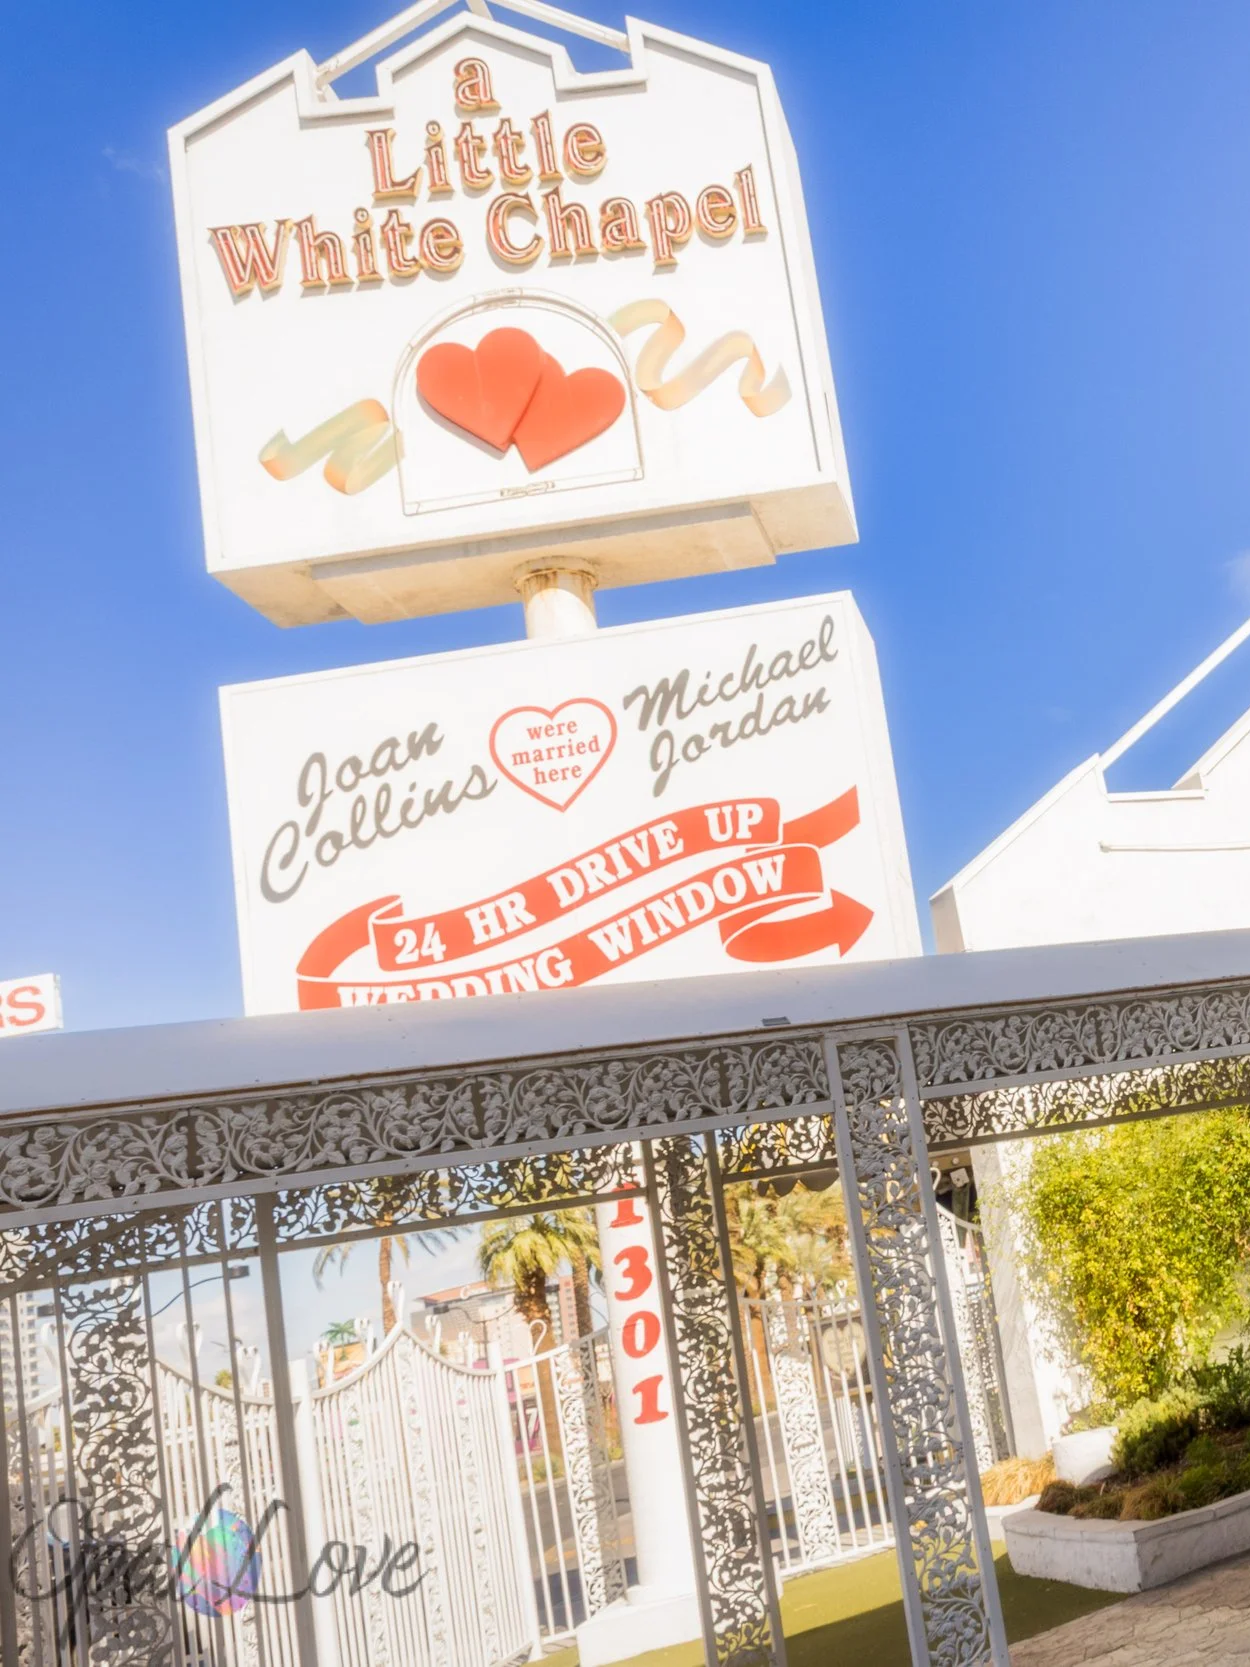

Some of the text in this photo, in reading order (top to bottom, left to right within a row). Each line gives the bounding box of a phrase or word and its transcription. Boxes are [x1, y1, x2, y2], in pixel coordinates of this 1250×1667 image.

[453, 55, 501, 111] a
[364, 109, 607, 201] Little
[207, 164, 768, 296] White Chapel
[526, 717, 579, 740] were
[622, 615, 839, 732] Michael
[297, 722, 444, 836] Joan
[511, 735, 602, 767] married
[533, 761, 583, 786] here
[648, 686, 831, 797] Jordan
[259, 763, 498, 904] Collins
[393, 802, 765, 966] 24 HR DRIVE UP
[589, 853, 786, 961] WINDOW
[609, 1174, 669, 1425] 1301
